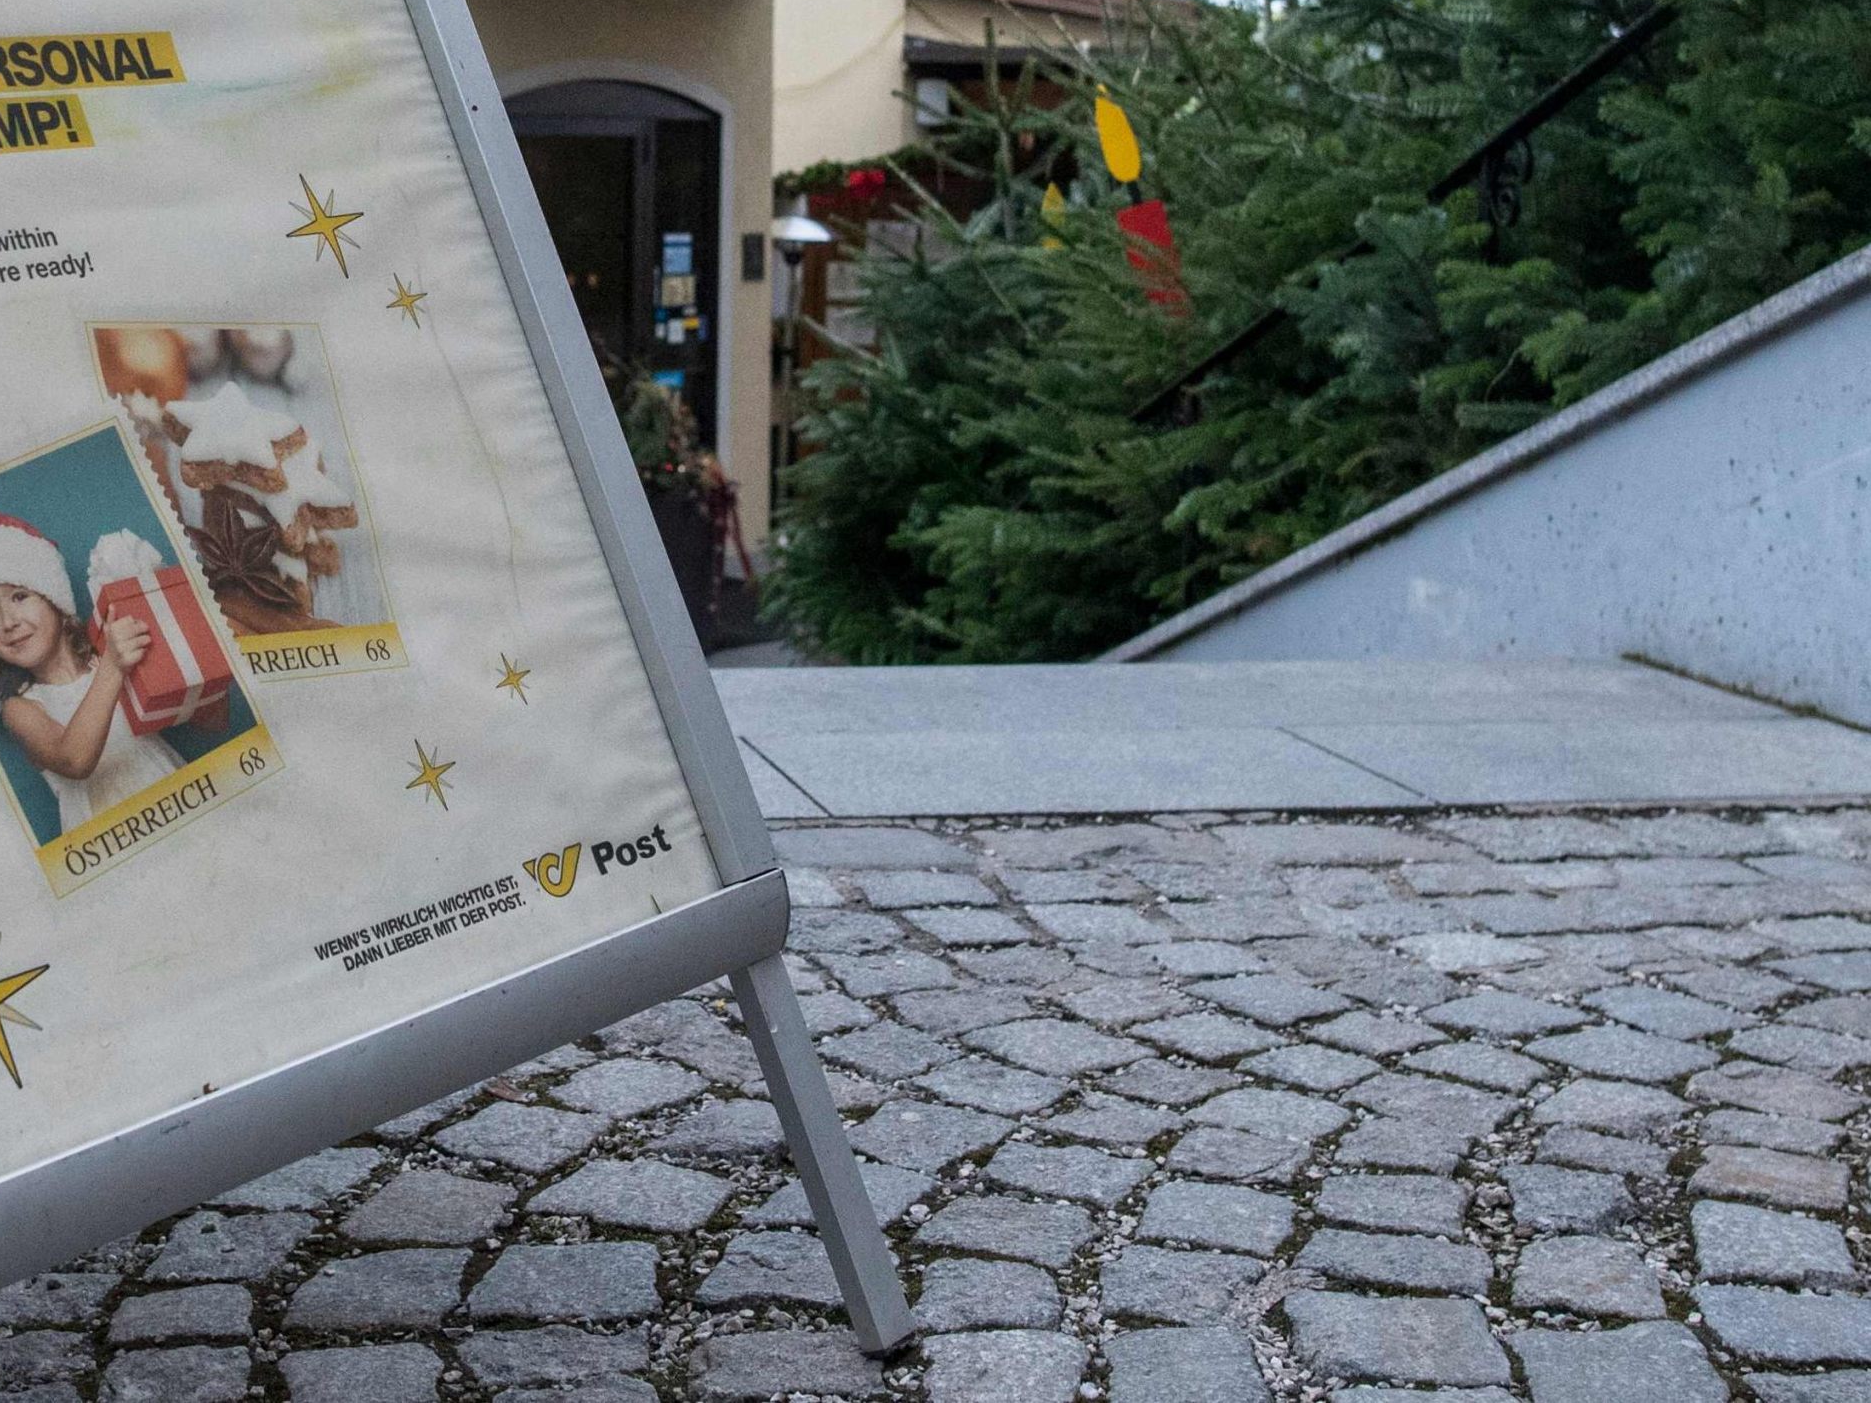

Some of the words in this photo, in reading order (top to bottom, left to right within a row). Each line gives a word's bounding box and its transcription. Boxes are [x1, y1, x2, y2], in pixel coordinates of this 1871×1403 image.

[26, 252, 94, 279] ready!
[242, 643, 341, 674] RREICH
[365, 638, 391, 662] 68
[64, 773, 218, 876] ÖSTERREICH
[239, 747, 266, 777] 68
[591, 823, 672, 875] Post
[314, 929, 371, 961] WENN'S
[371, 904, 439, 940] WIRKLICH
[438, 884, 494, 915] WICHTIG
[495, 875, 519, 895] IST,
[342, 946, 384, 972] DANN
[384, 927, 434, 956] LIEBER
[433, 917, 458, 938] MIT
[459, 906, 489, 928] DER
[488, 893, 527, 916] POST.
